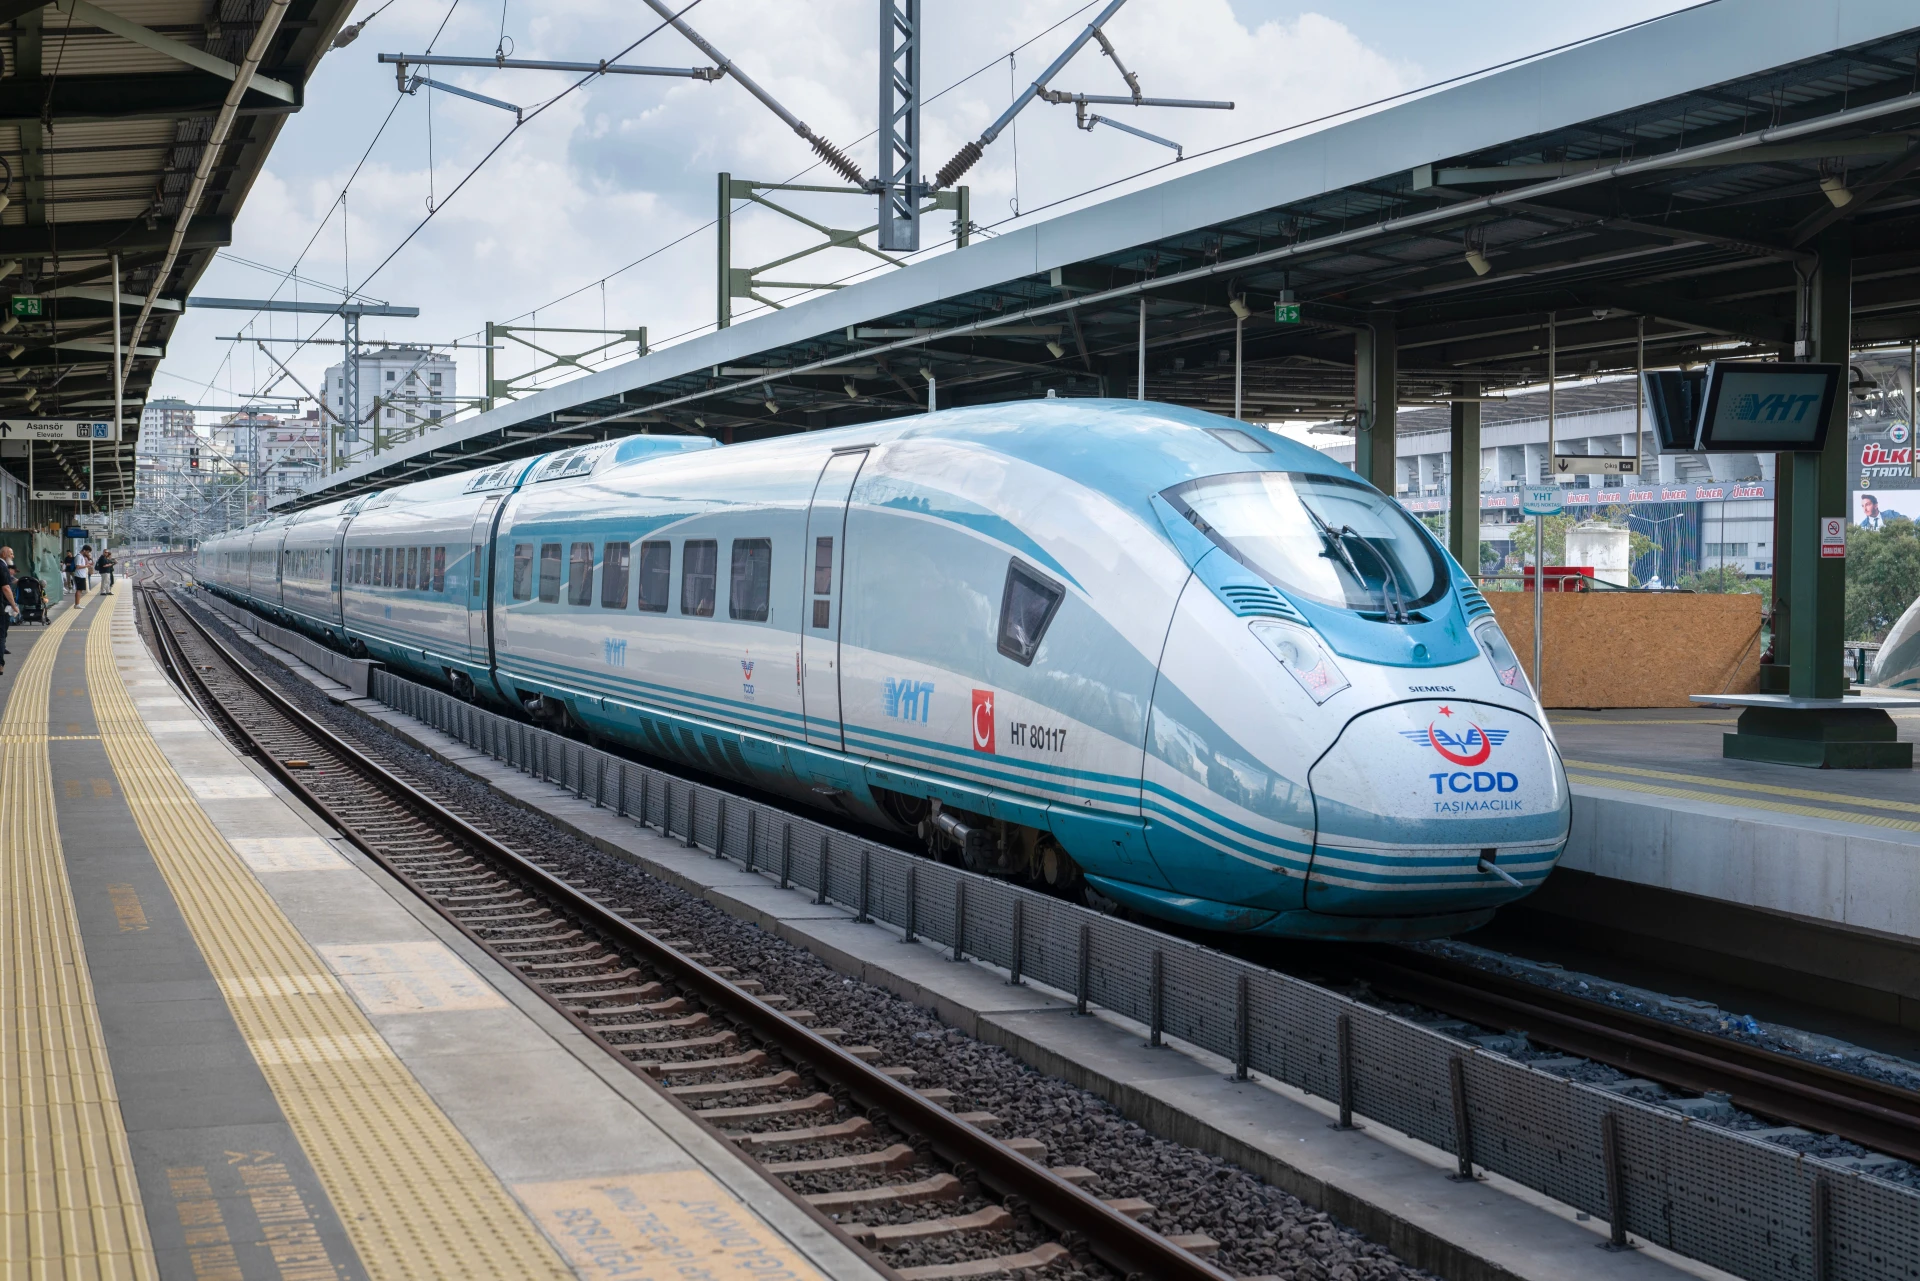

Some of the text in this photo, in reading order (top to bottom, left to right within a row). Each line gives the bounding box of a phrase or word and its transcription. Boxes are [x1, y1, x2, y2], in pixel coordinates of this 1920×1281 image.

[1747, 393, 1819, 421] YHT
[26, 422, 64, 431] Asansör
[1861, 442, 1920, 467] ÜLKE
[1533, 492, 1553, 501] YHT
[1567, 491, 1590, 504] ÜLKER
[1597, 490, 1621, 503] ÜLKER
[1628, 488, 1653, 501] ÜLKER
[1661, 487, 1687, 500] ÜLKER
[1695, 486, 1723, 499] ÜLKER
[1732, 484, 1765, 498] ÜLKER
[885, 676, 935, 723] YHT
[1408, 685, 1456, 693] SIEMENS
[1011, 722, 1067, 752] HT 80117
[1429, 771, 1519, 795] TCDD
[1433, 800, 1523, 814] TAŞIMACILIK
